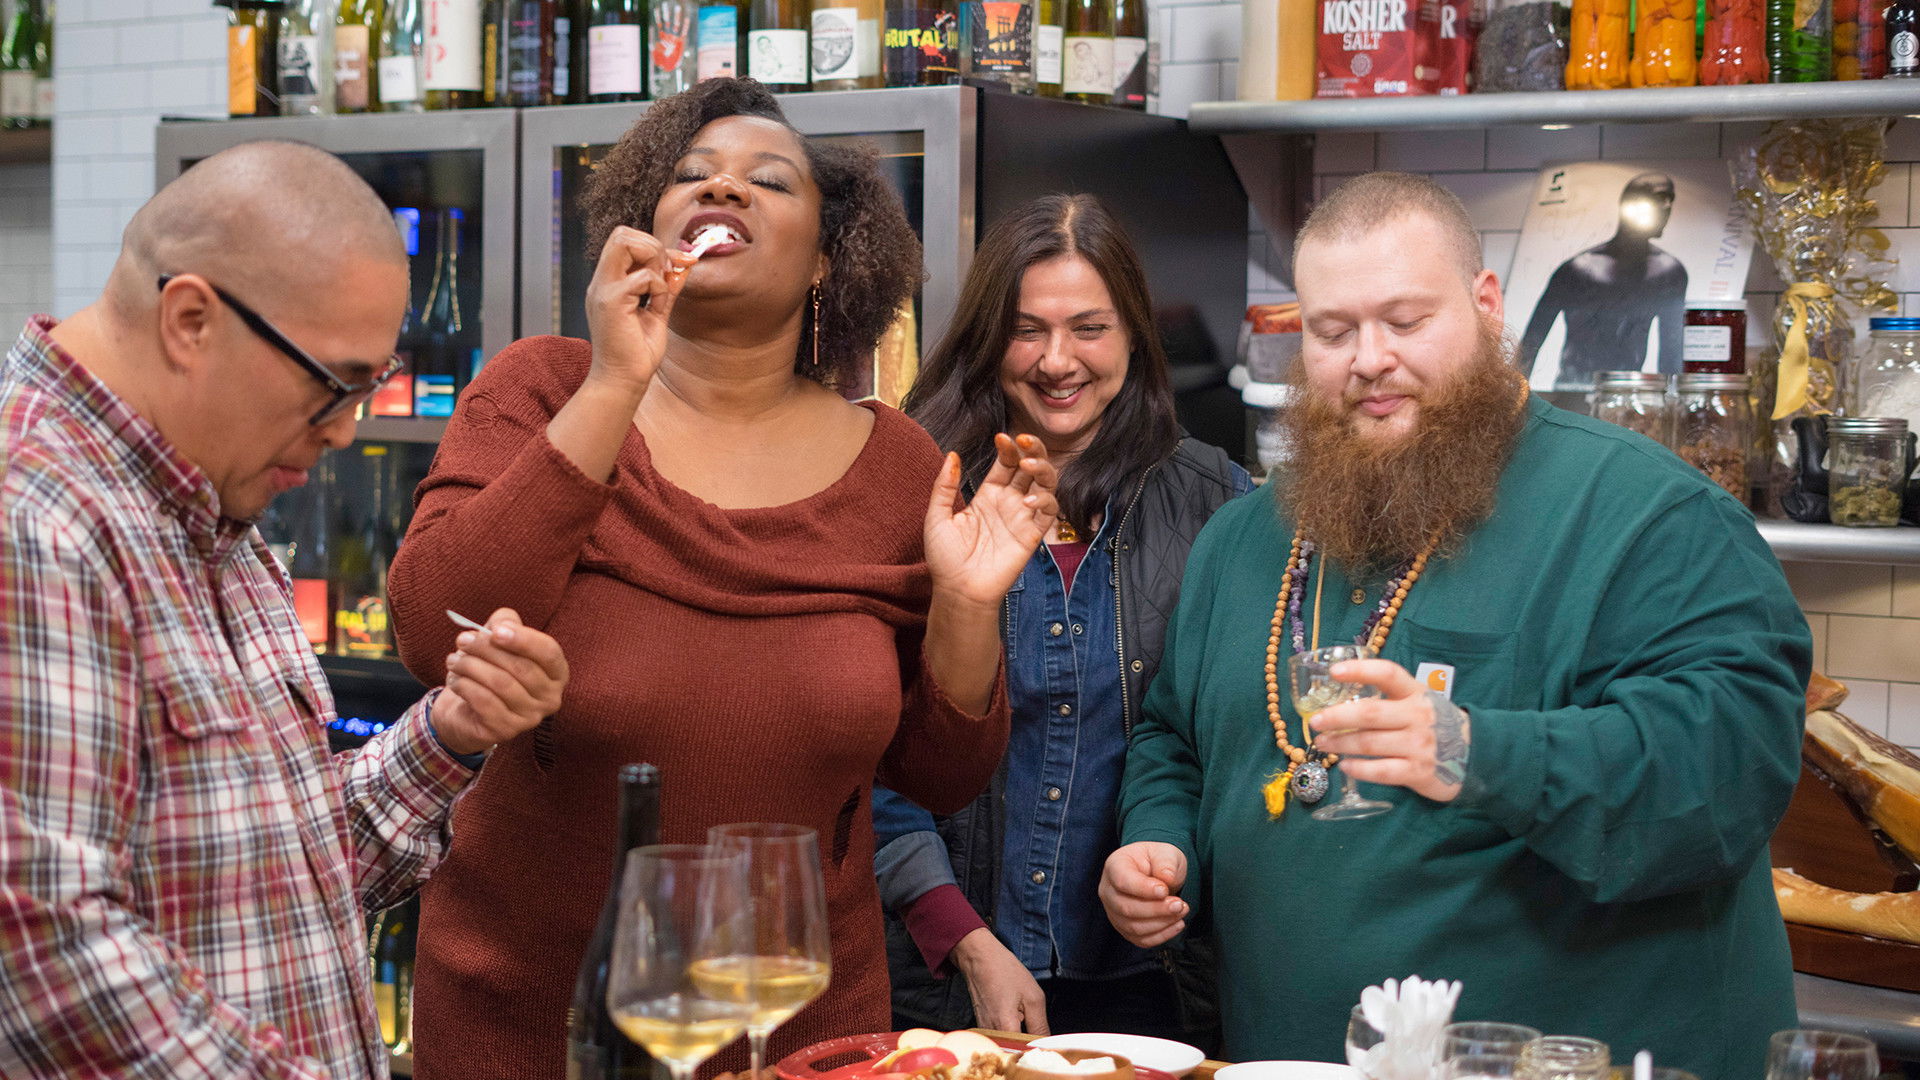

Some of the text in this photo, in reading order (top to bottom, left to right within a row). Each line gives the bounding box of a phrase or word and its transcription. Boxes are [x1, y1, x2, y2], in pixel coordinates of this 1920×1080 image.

[1323, 0, 1407, 34] KOSHER
[885, 26, 945, 49] BRUTAL
[1343, 32, 1382, 51] SALT
